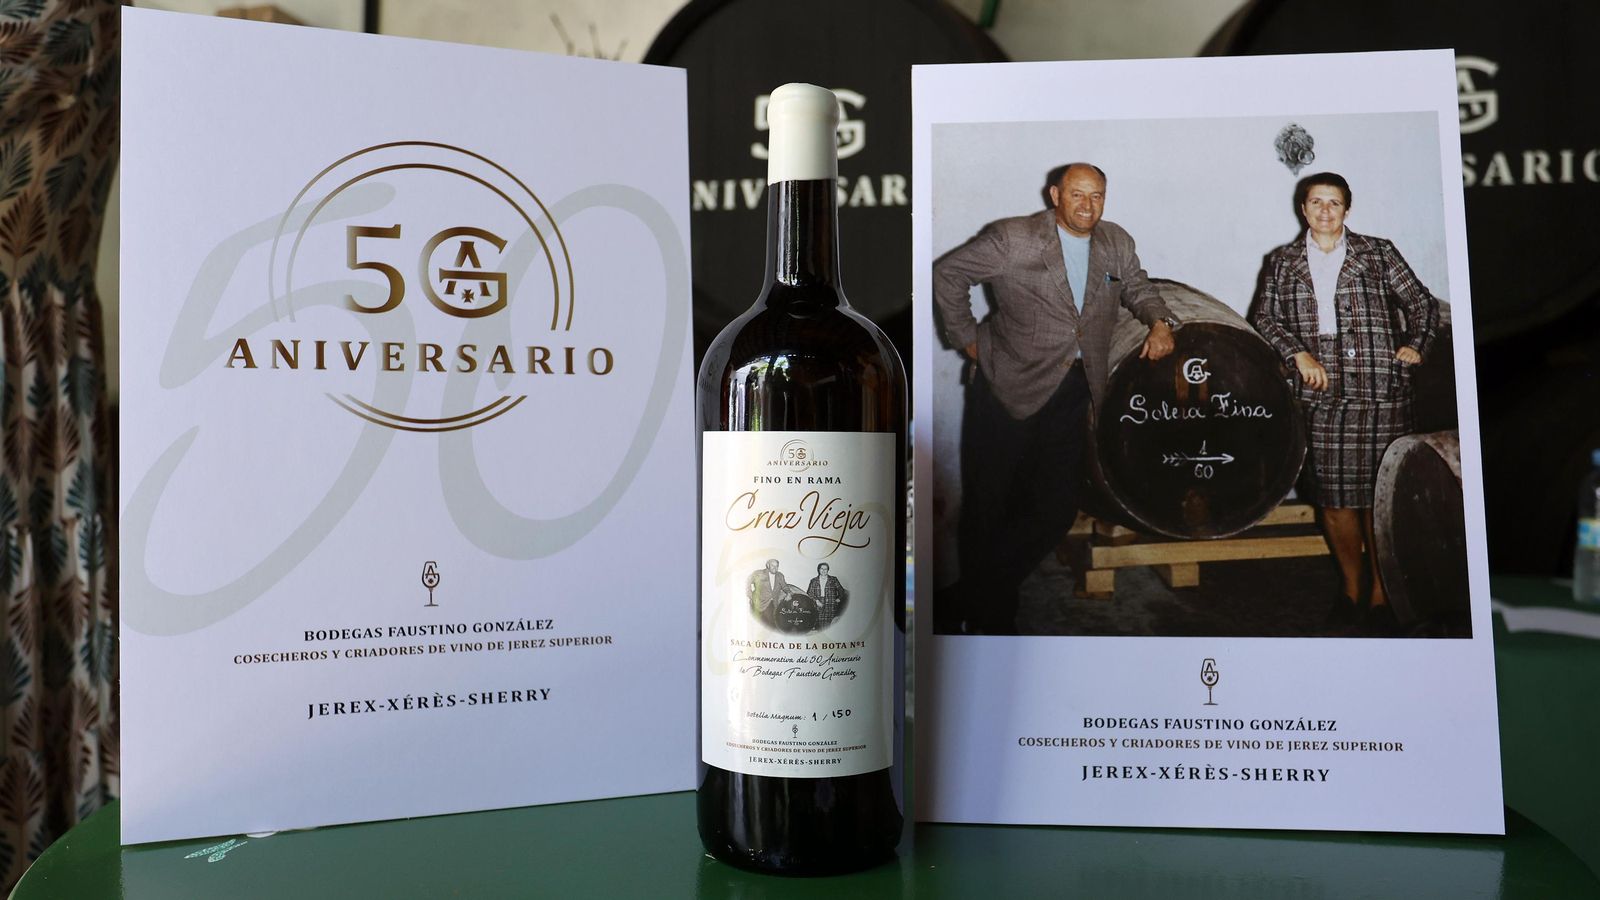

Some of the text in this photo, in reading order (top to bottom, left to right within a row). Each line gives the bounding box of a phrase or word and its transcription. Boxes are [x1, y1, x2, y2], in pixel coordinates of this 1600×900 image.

[223, 336, 615, 376] ANIVERSARIO
[1210, 391, 1273, 419] Fina
[766, 459, 829, 467] ANIVERSARIO
[753, 476, 842, 484] FINO EN RAMA
[725, 489, 871, 559] Cruz Vieja
[303, 619, 555, 642] BODEGAS FAUSTINO GONZÁLEZ
[233, 635, 613, 665] COSECHEROS Y CRIADORES DE VINO DE JEREZ SUPERIOR
[730, 639, 751, 648] SACA
[755, 640, 785, 649] ÚNICA
[788, 642, 802, 650] DE
[805, 642, 818, 650] LA
[821, 642, 847, 650] BOTA
[732, 651, 862, 666] Conmemorativa del 50 Aniversario
[745, 664, 783, 677] Bodegas
[783, 667, 822, 679] Faustino
[821, 666, 858, 680] González
[306, 688, 552, 720] JEREX-XÉRÈS-SHERRY
[811, 712, 818, 721] 1
[832, 709, 852, 719] 150
[1082, 716, 1338, 732] BODEGAS FAUSTINO GONZÁLEZ
[1018, 736, 1404, 753] COSECHEROS Y CRIADORES DE VINO DE JEREZ SUPERIOR
[1081, 763, 1331, 782] JEREX-XÉRÈS-SHERRY
